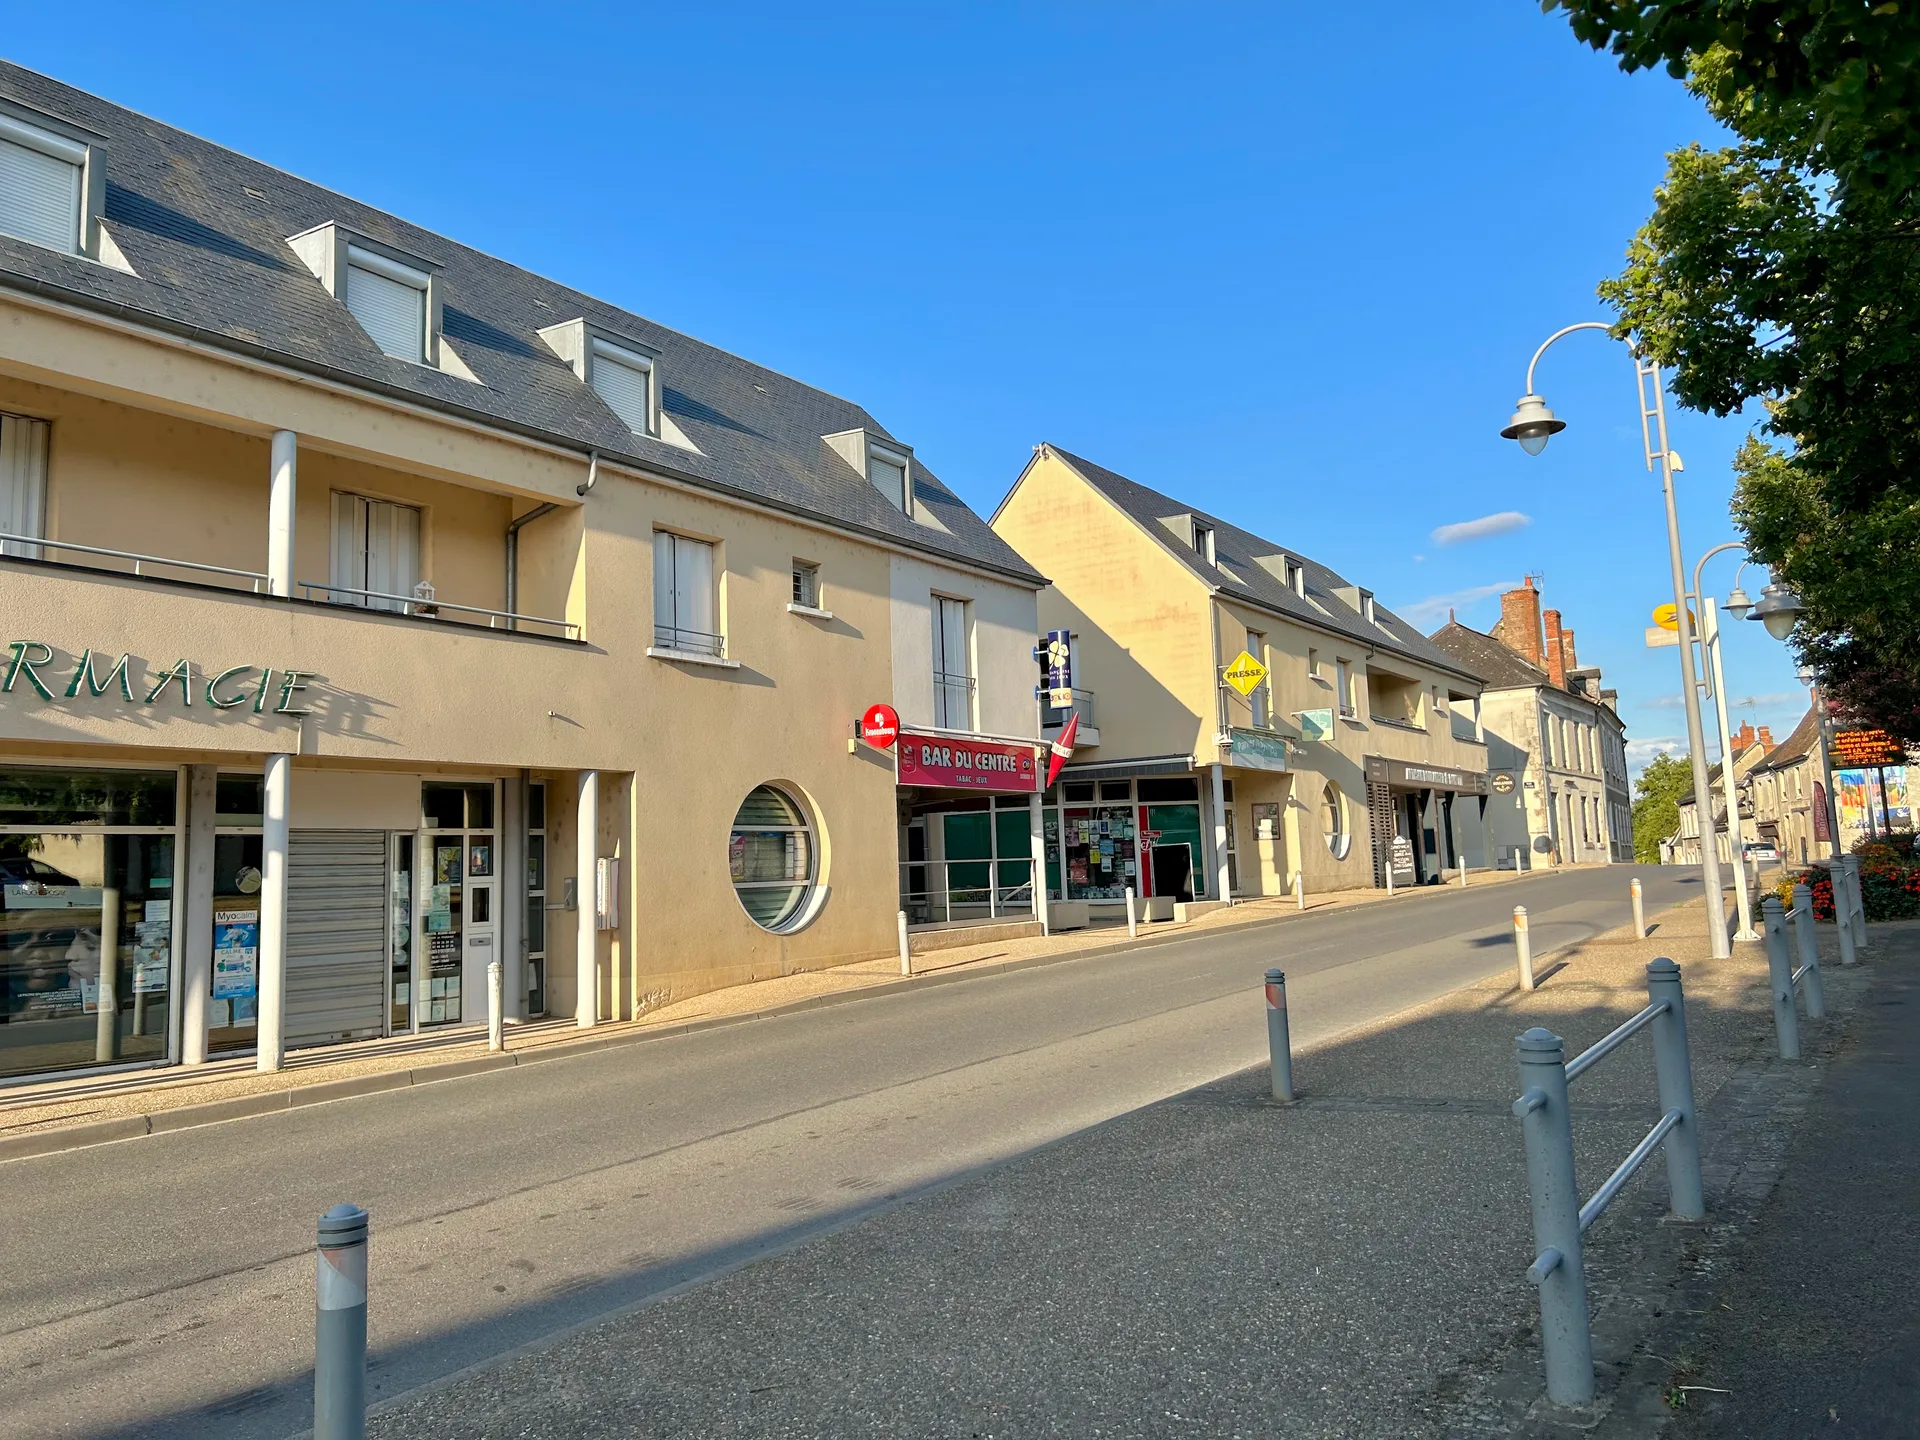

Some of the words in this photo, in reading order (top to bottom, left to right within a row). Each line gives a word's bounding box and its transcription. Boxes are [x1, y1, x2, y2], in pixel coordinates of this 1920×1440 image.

[2, 639, 316, 714] RMACIE
[1226, 668, 1262, 679] PRESSE
[921, 745, 953, 768] BAR
[955, 751, 973, 769] DU
[974, 752, 1017, 773] CENTRE
[956, 775, 972, 783] TABAC
[976, 776, 988, 784] JEUX
[217, 911, 256, 922] Myocalm
